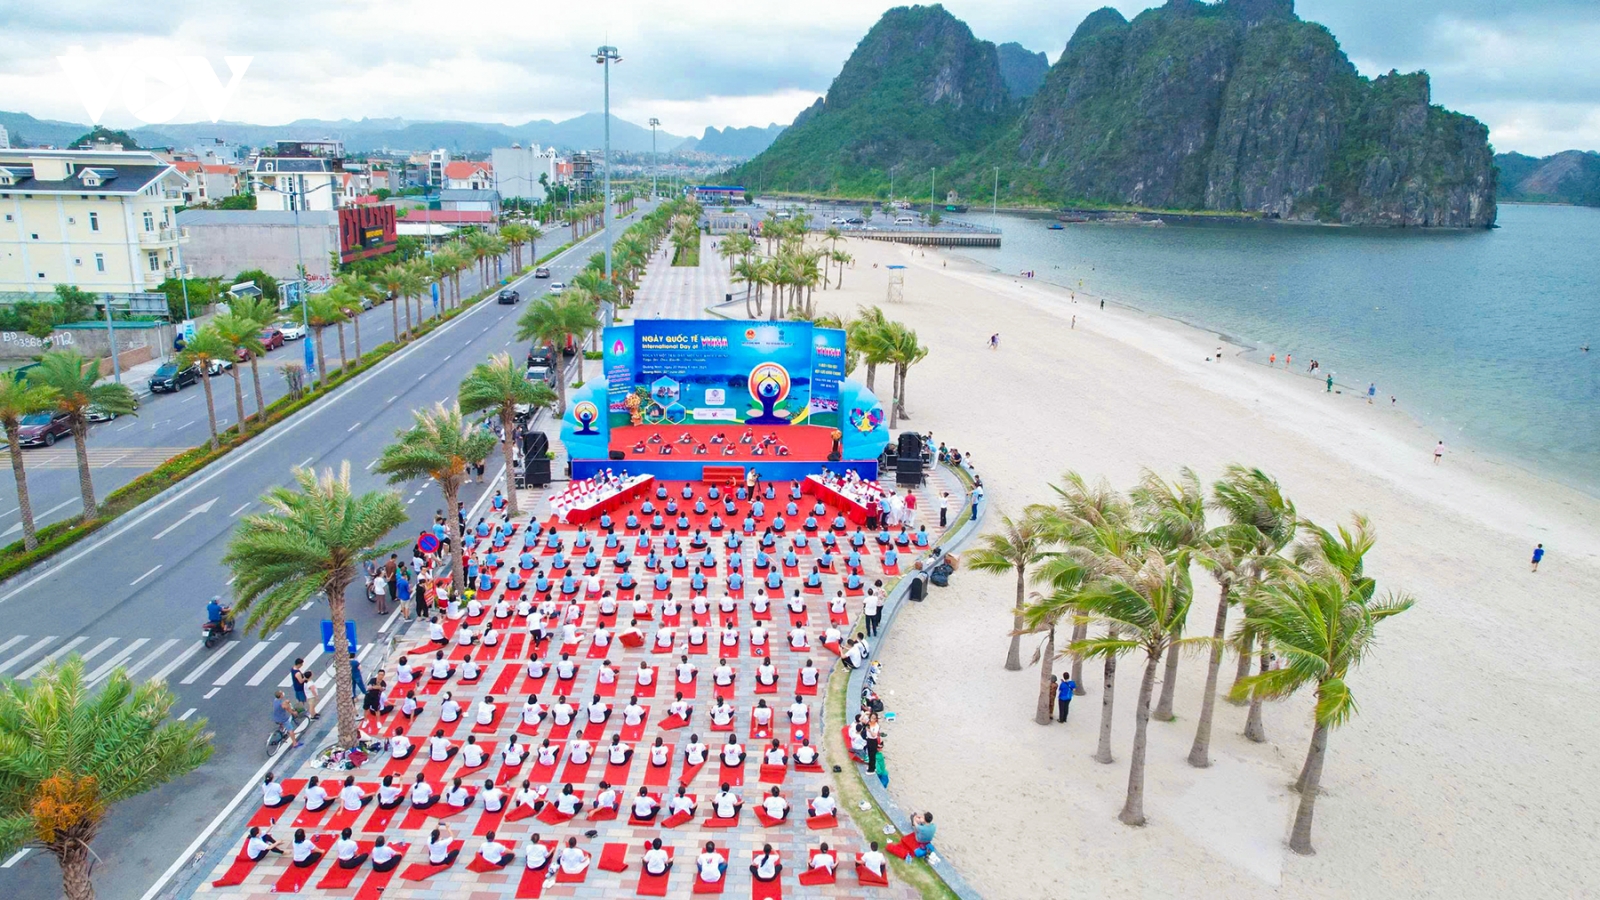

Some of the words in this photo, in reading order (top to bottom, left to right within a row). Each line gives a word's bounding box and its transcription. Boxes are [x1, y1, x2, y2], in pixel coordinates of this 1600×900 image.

[642, 334, 663, 343] NGÀY
[665, 334, 688, 343] QUỐC
[690, 334, 699, 343] TẾ
